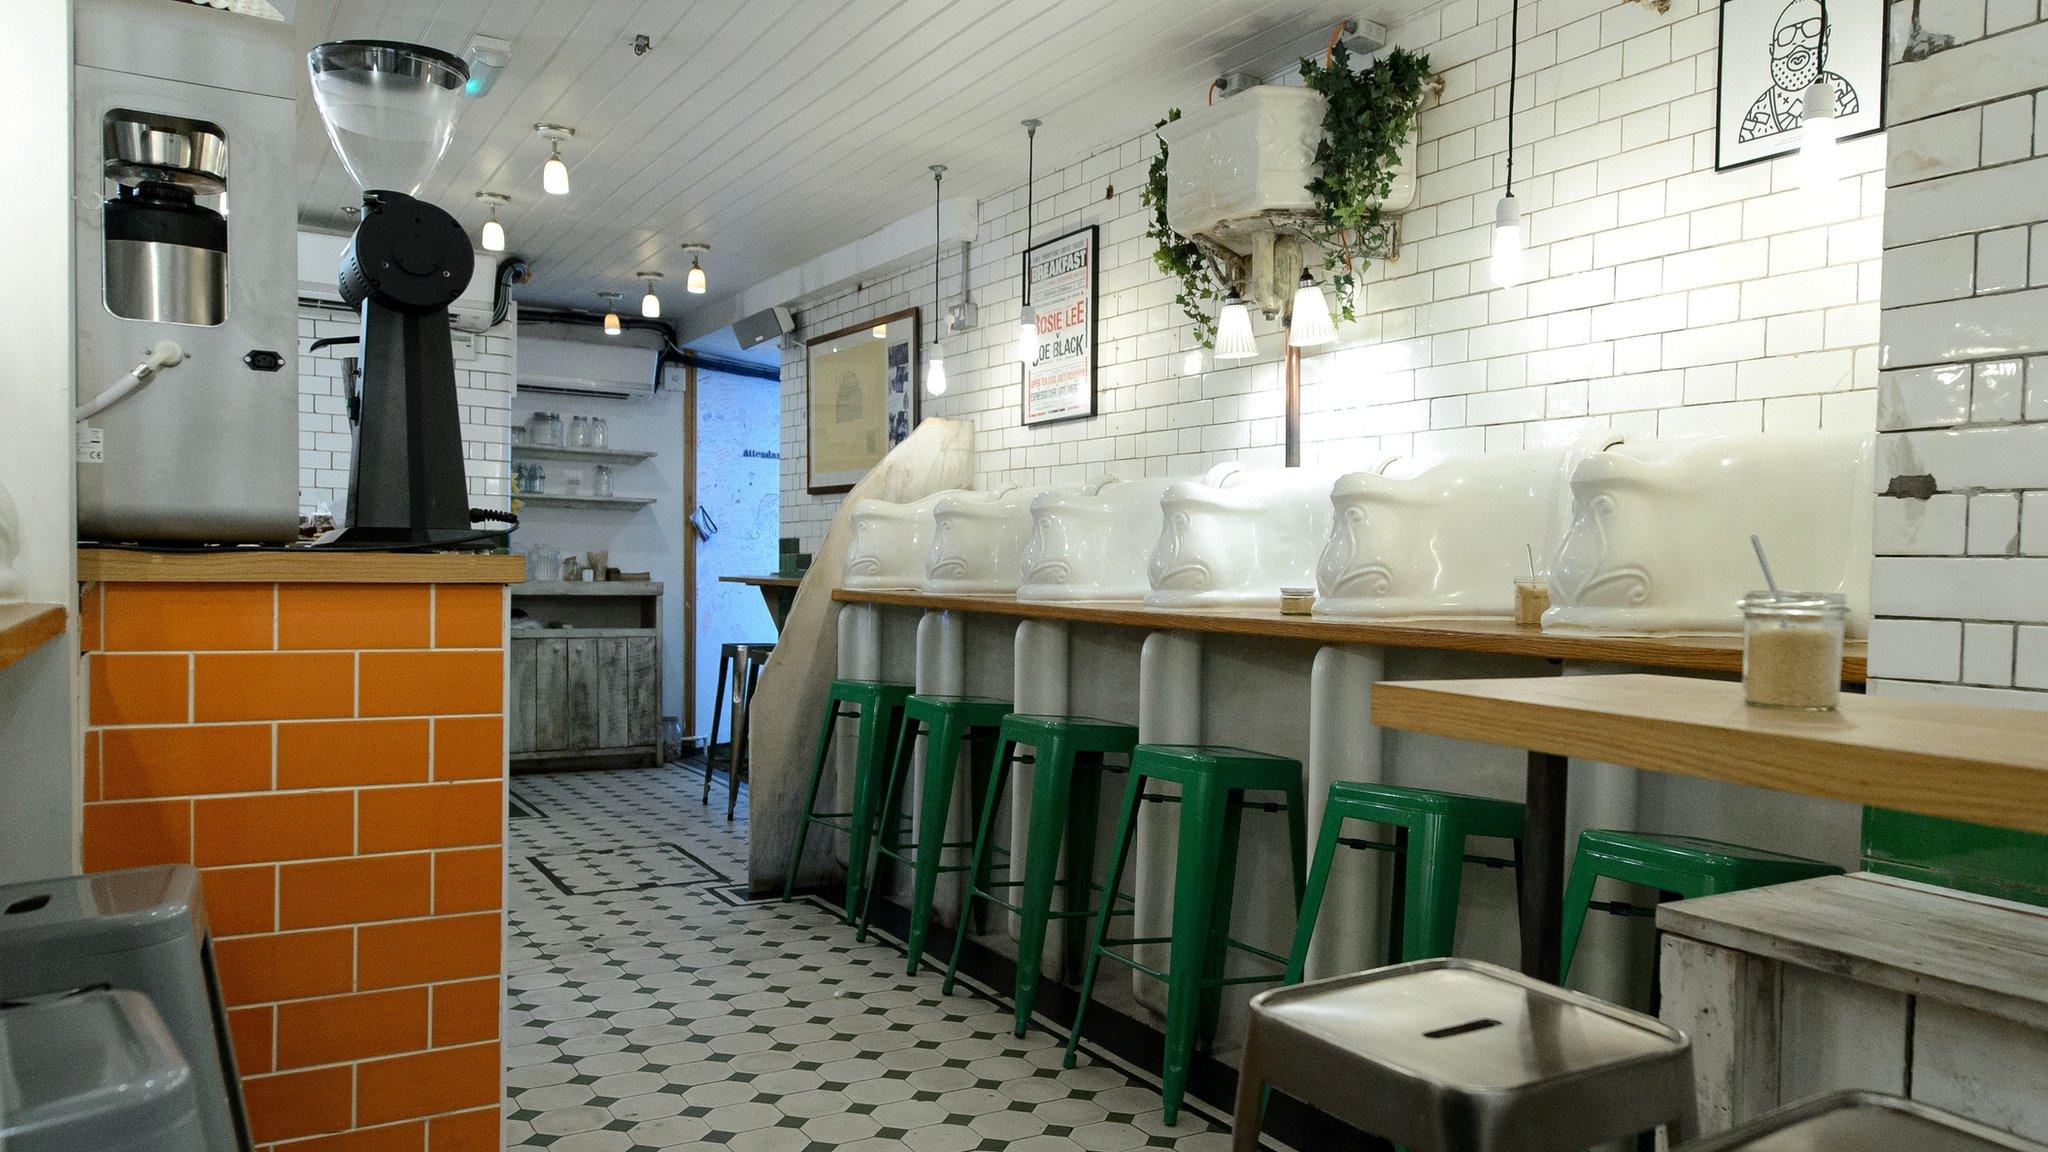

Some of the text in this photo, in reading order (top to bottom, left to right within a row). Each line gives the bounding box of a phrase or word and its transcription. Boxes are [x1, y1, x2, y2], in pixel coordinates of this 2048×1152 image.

[1031, 250, 1086, 283] BREAKFAST
[1066, 300, 1084, 327] LEE
[1053, 334, 1084, 358] BLACK
